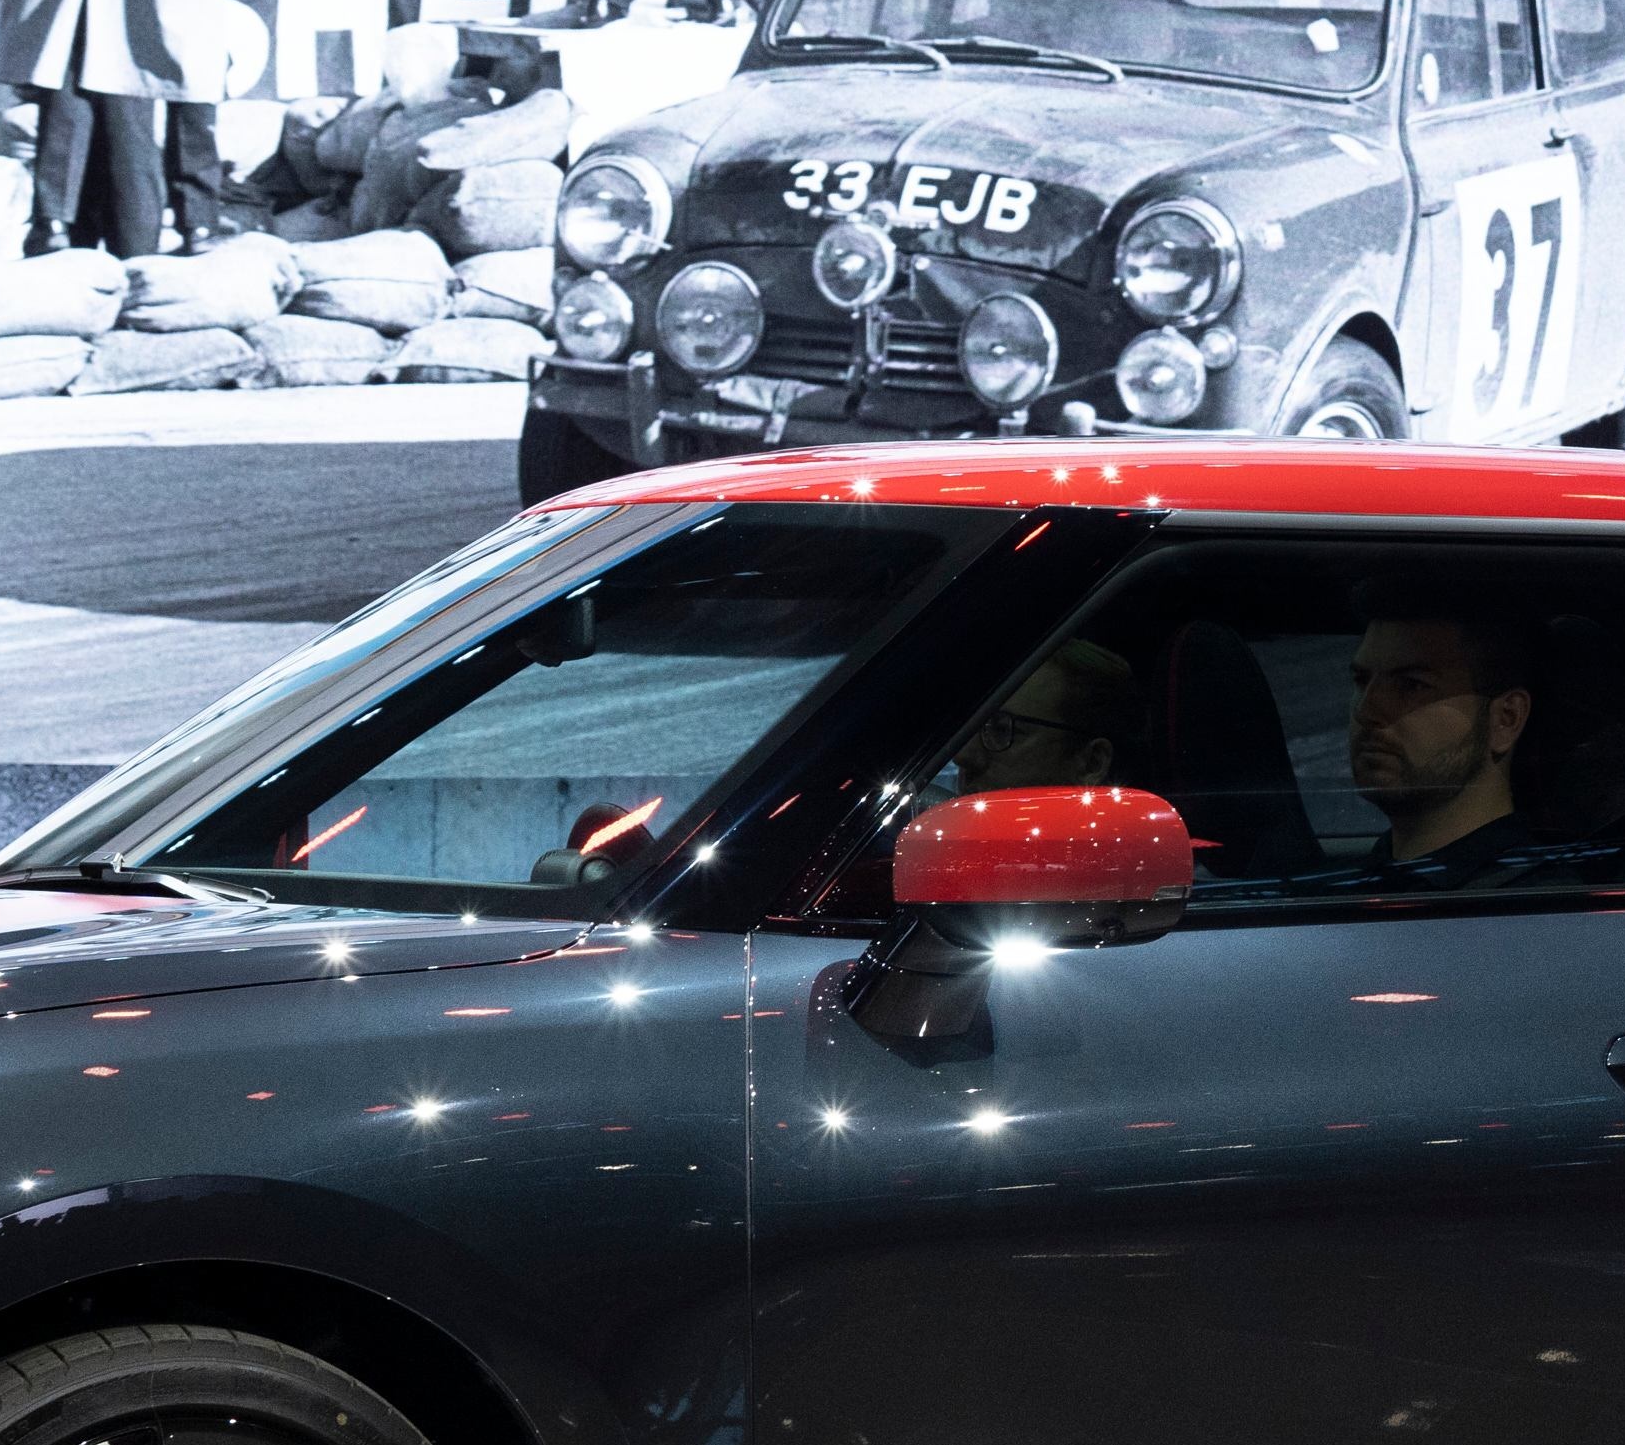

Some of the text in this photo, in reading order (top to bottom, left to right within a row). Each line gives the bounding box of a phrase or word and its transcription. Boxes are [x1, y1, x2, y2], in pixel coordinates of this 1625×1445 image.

[782, 158, 1038, 233] 33 EJB
[1473, 195, 1564, 416] 37
